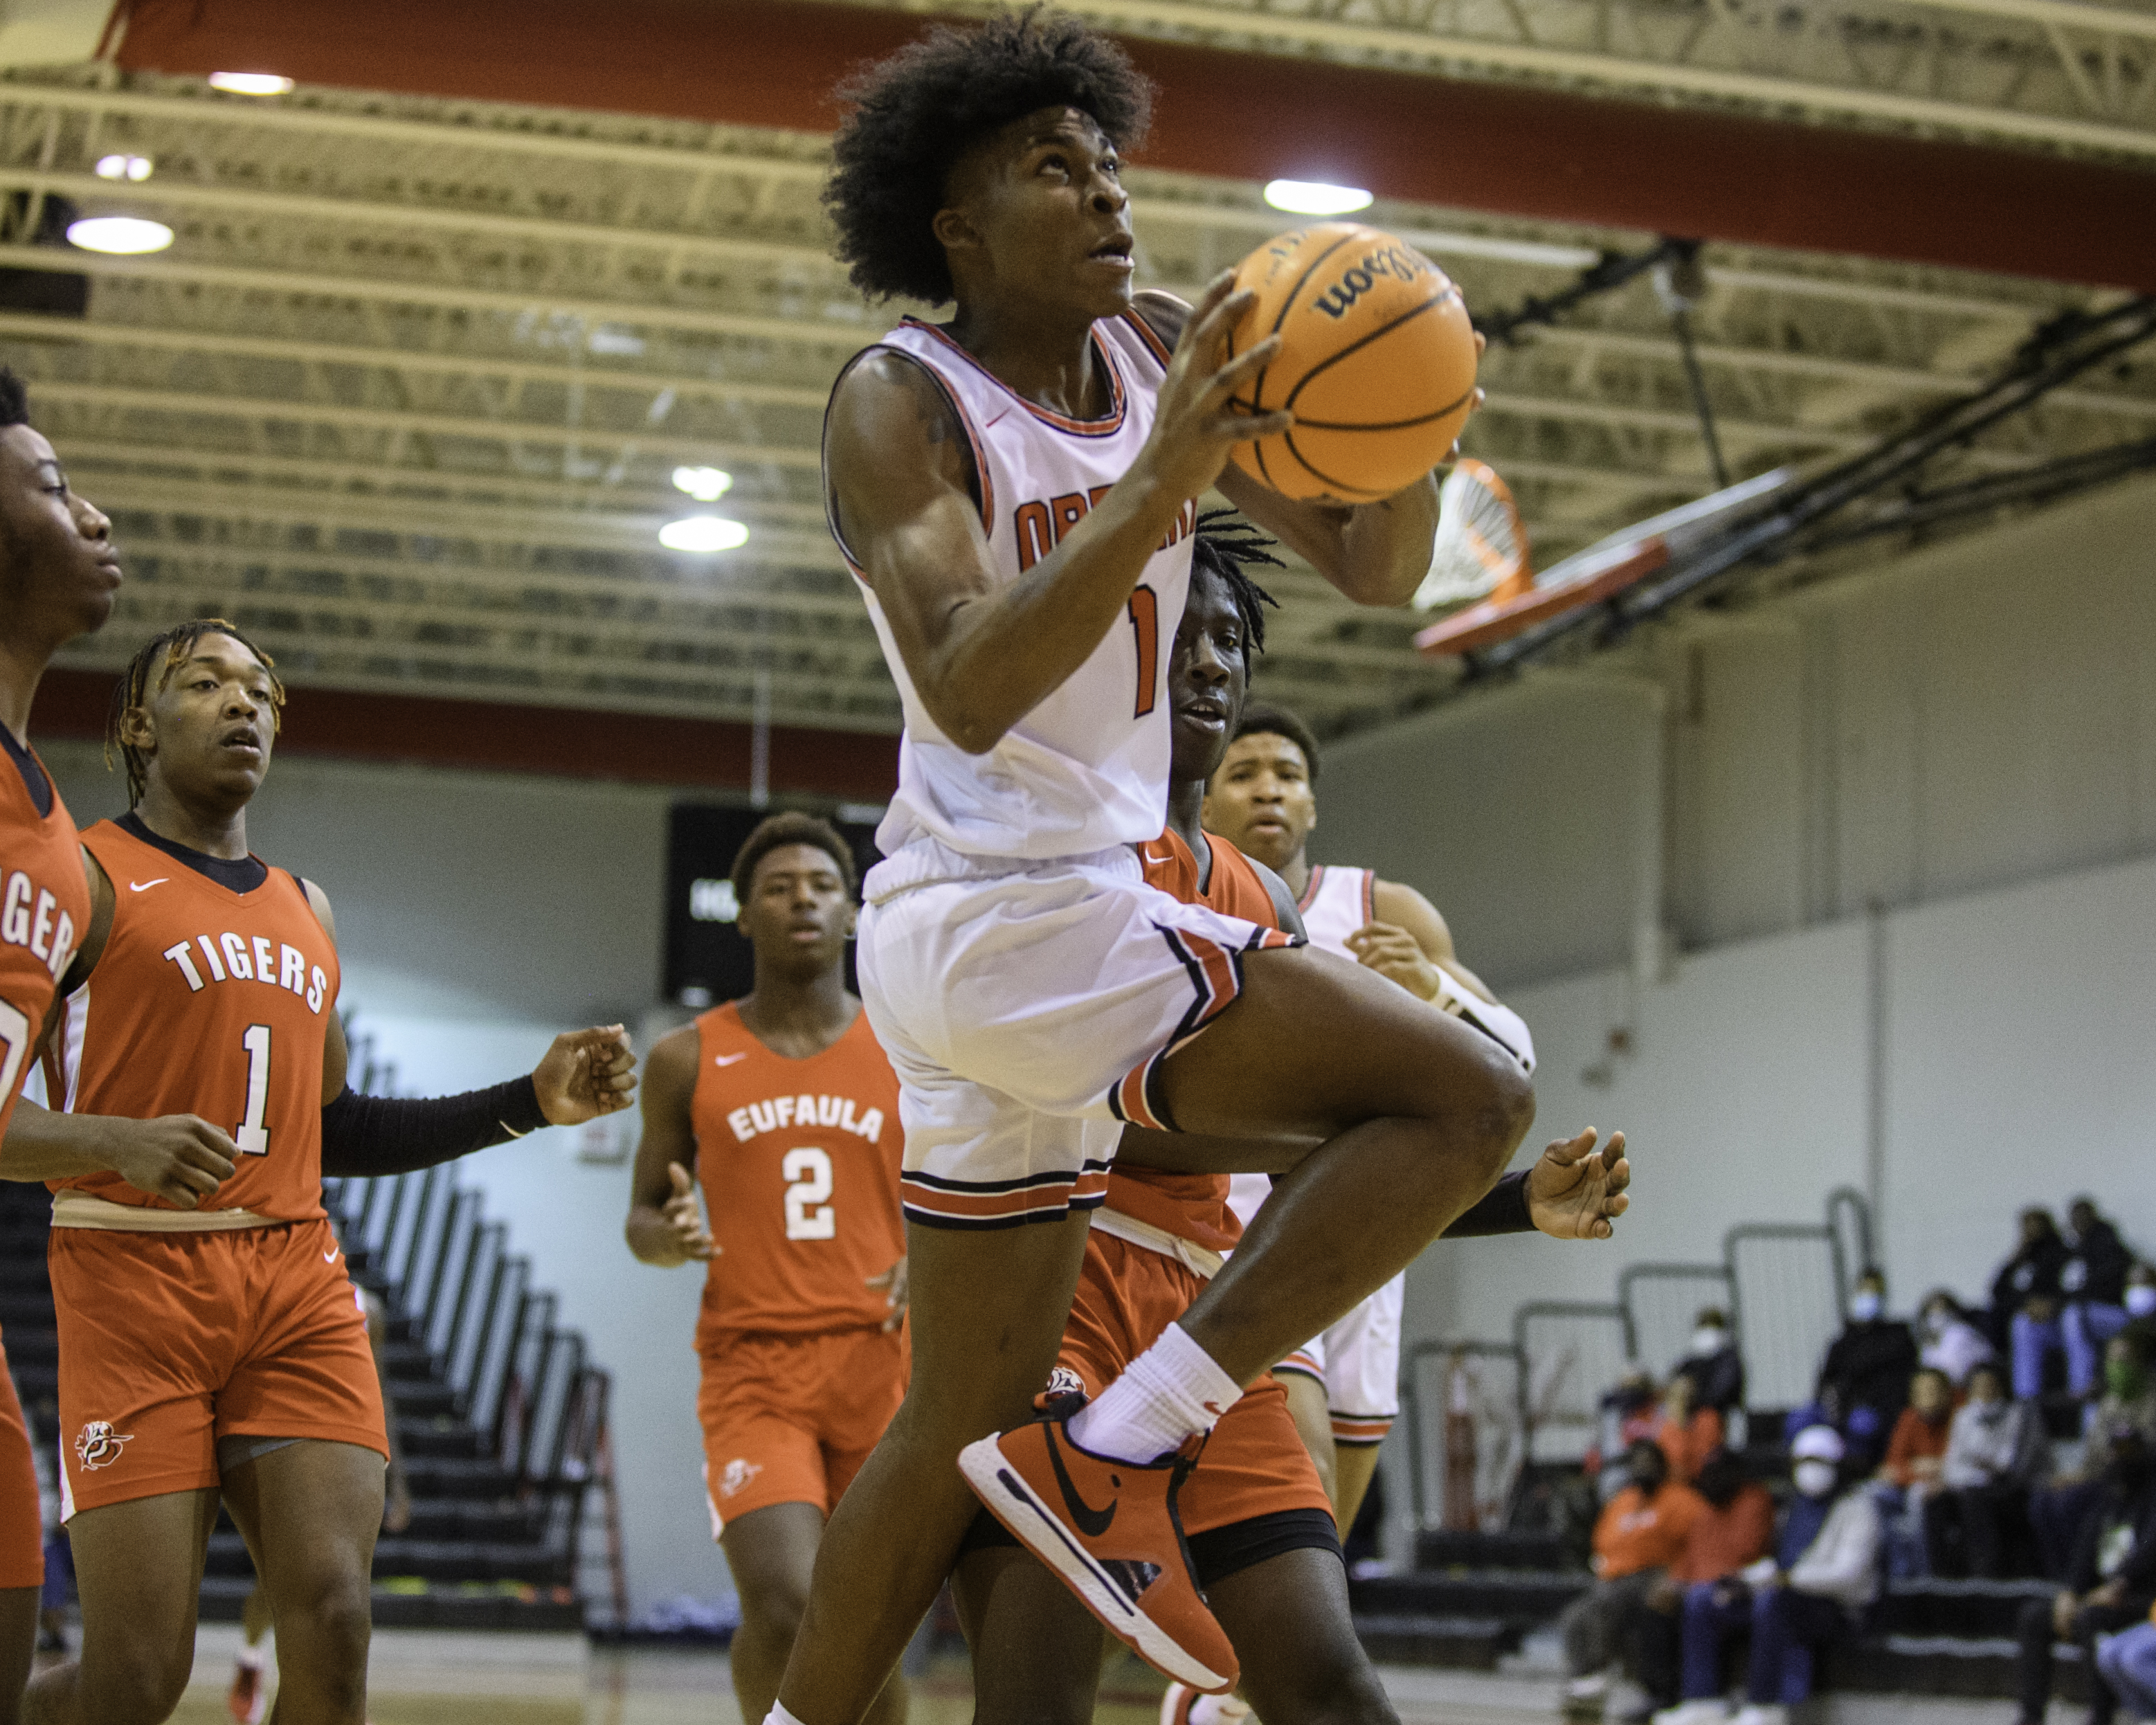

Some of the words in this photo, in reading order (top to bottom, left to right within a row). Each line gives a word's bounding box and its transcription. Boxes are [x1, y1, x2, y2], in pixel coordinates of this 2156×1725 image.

[1127, 584, 1159, 720] 1
[0, 866, 78, 985] GER
[163, 932, 327, 1015] TIGERS
[237, 1022, 271, 1156] 1
[727, 1094, 884, 1144] EUFAULA
[782, 1146, 835, 1240] 2
